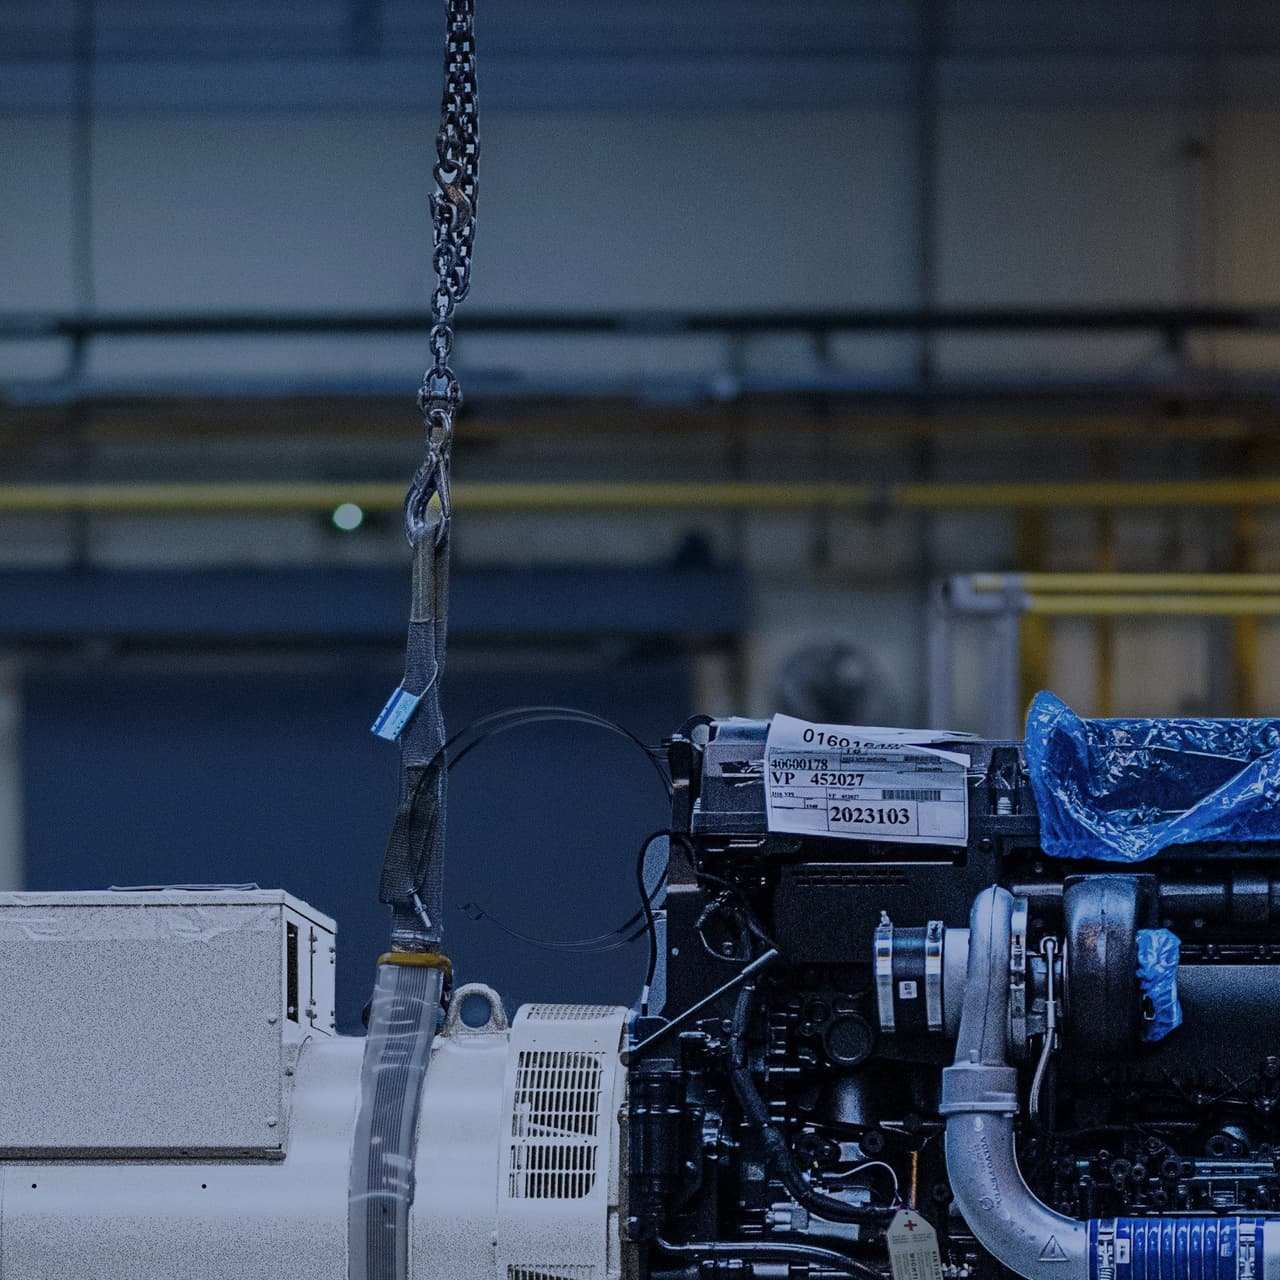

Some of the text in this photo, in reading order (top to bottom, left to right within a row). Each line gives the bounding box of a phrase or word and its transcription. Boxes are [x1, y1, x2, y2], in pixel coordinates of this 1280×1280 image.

[772, 772, 865, 787] VP 452027
[830, 806, 910, 825] 2023103
[980, 1135, 993, 1169] VOLVO
